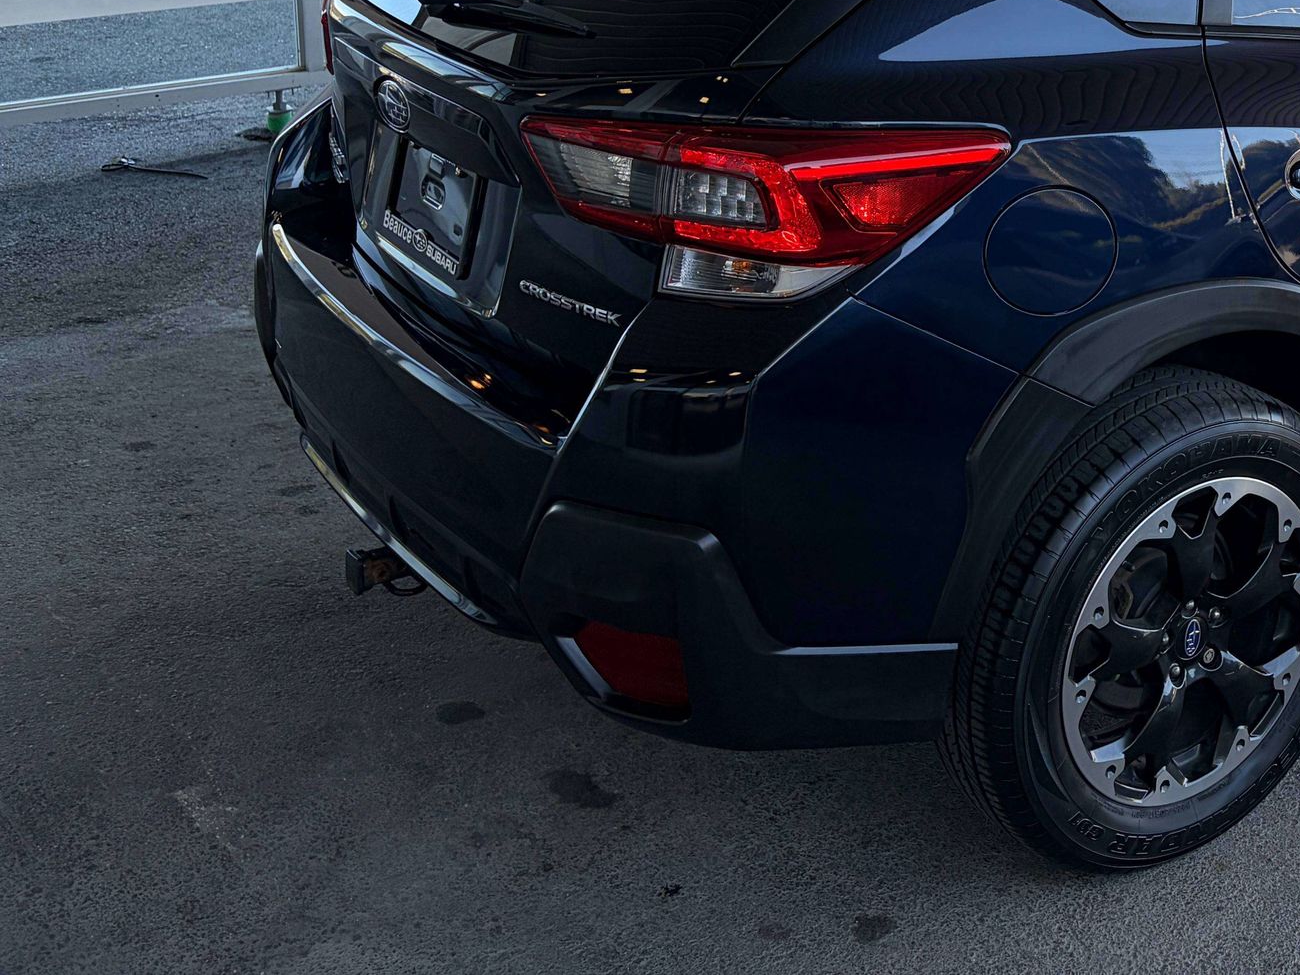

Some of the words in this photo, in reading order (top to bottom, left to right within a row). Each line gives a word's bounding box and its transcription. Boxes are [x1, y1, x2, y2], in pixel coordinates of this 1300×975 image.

[382, 211, 414, 245] Beauce
[425, 242, 458, 275] SUBARU
[518, 279, 623, 328] CROSSTREK
[1089, 432, 1283, 543] YOKOHAMA
